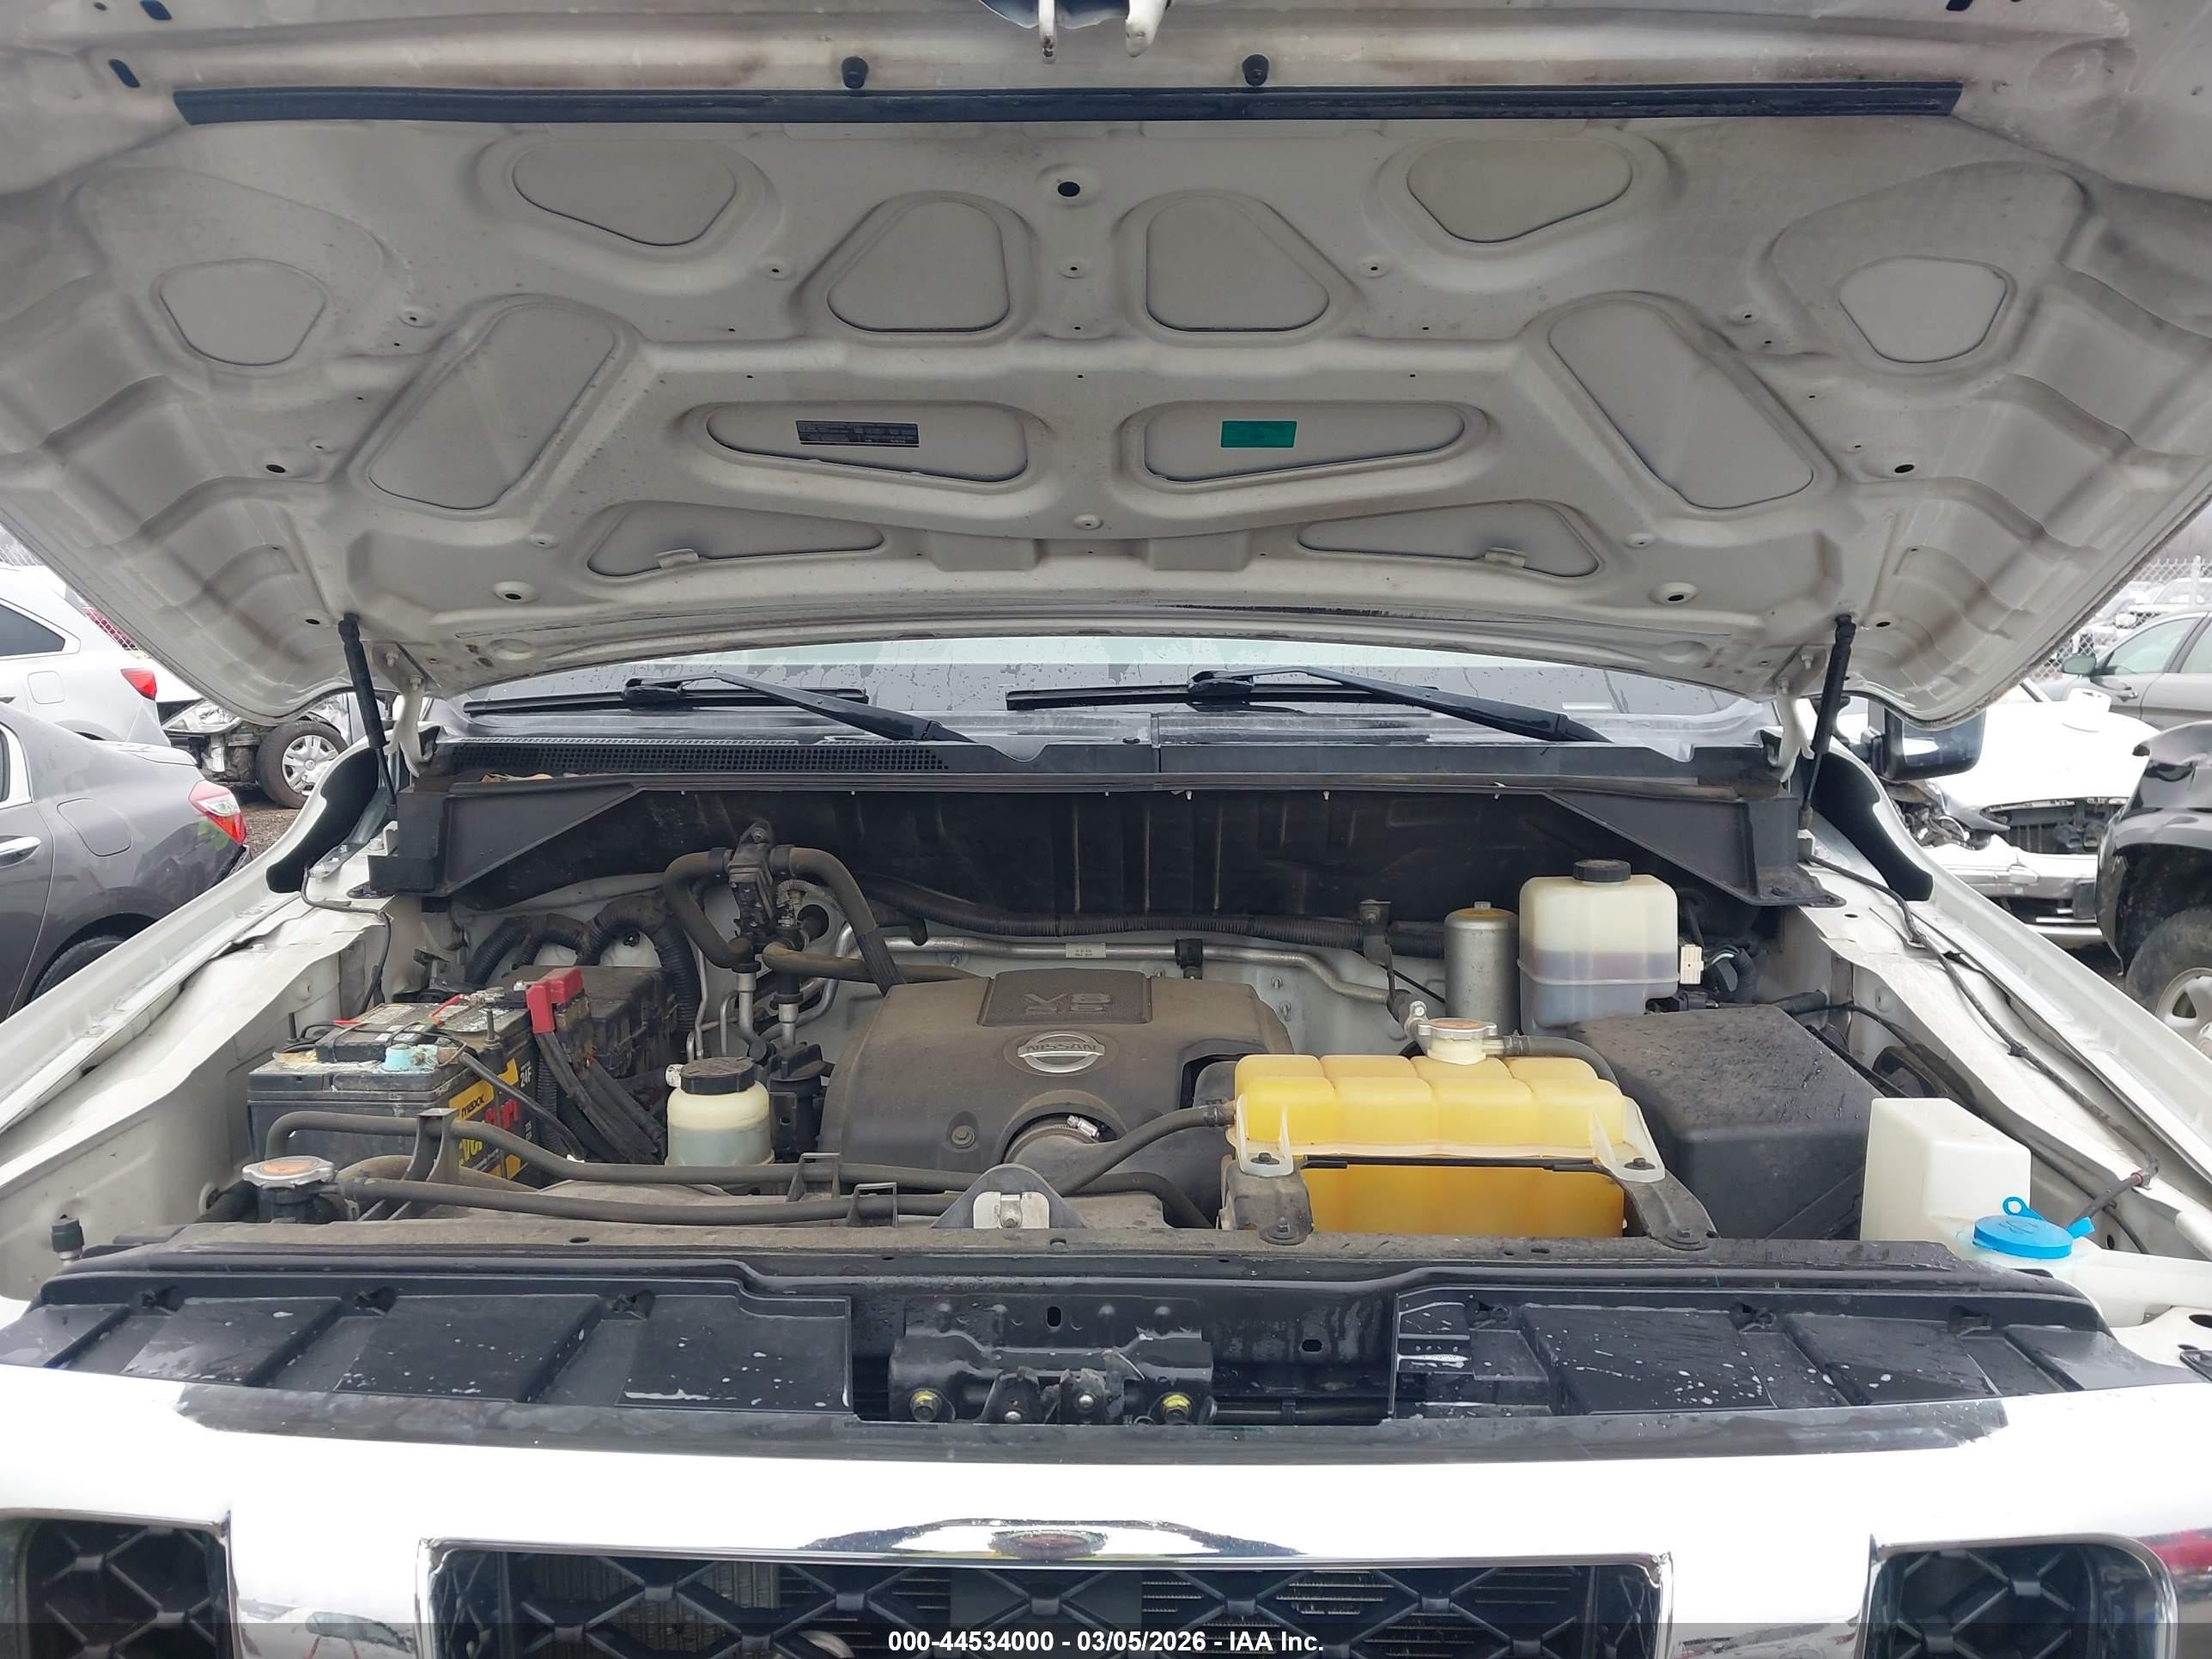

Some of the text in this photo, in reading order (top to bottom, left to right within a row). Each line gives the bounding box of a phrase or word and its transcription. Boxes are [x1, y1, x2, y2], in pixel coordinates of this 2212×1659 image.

[1023, 992, 1112, 1005] V8
[1026, 1042, 1097, 1052] NISSAN
[520, 1065, 532, 1088] 24F
